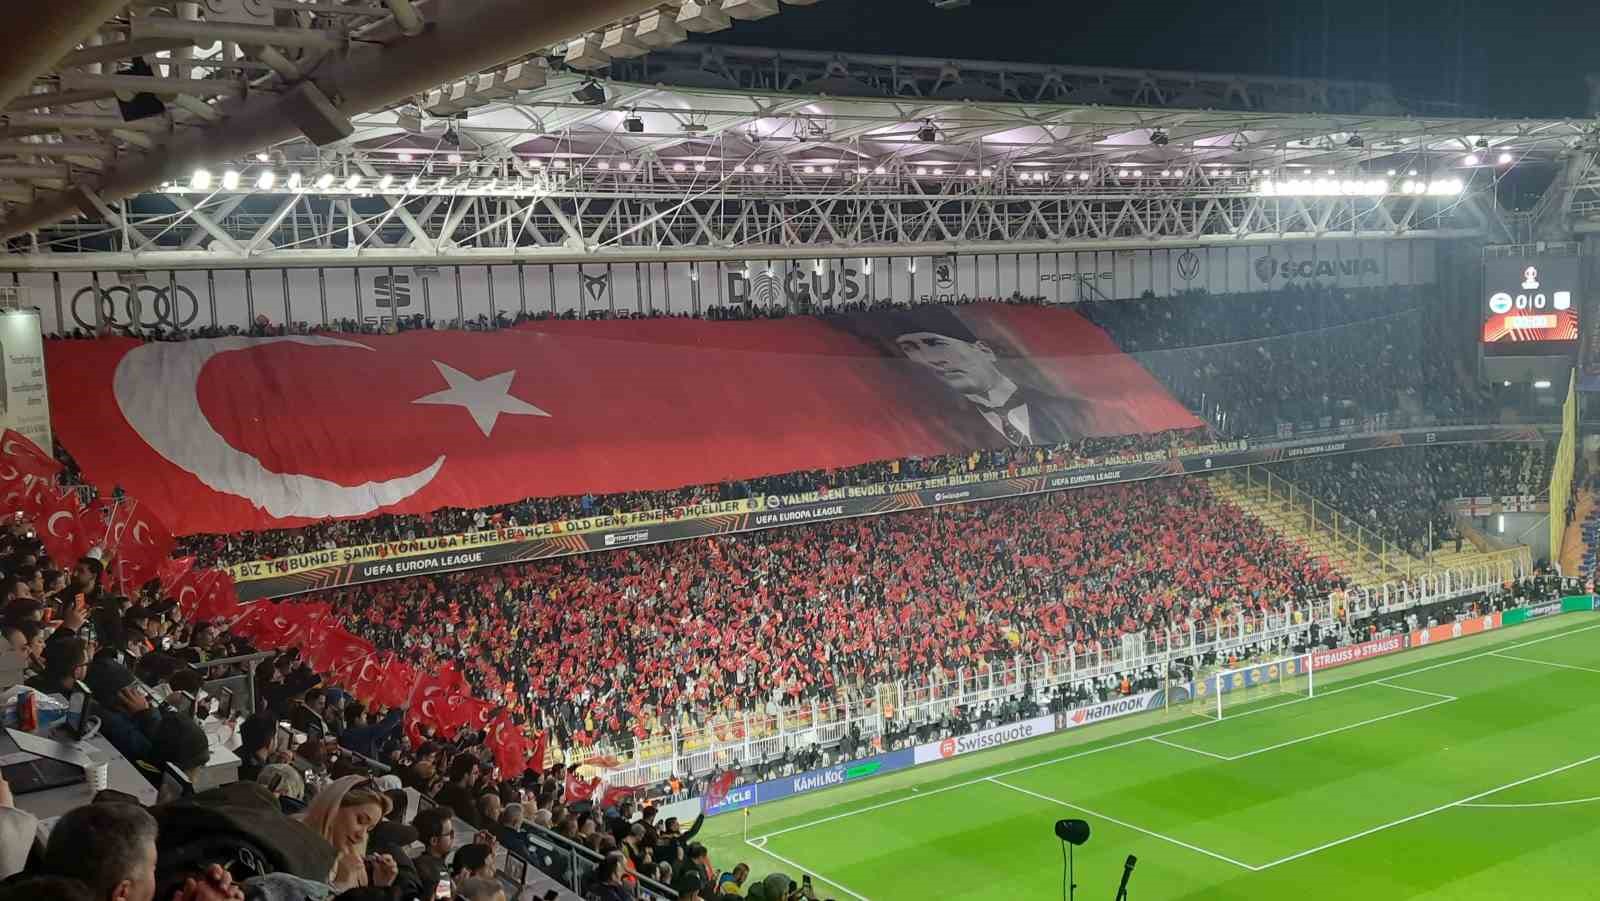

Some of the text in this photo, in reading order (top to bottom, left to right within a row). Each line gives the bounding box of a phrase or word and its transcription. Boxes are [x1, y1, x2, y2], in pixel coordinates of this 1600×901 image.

[1040, 271, 1113, 282] PORSCHE
[1281, 257, 1380, 279] SCANIA
[566, 519, 592, 532] OLD
[755, 505, 843, 525] UEFA EUROPA LEAGUE
[363, 552, 482, 577] UEFA EUROPA LEAGUE
[1314, 648, 1353, 668] STRAUSS
[1361, 638, 1400, 656] STRAUSS
[957, 723, 1033, 753] Swissquote
